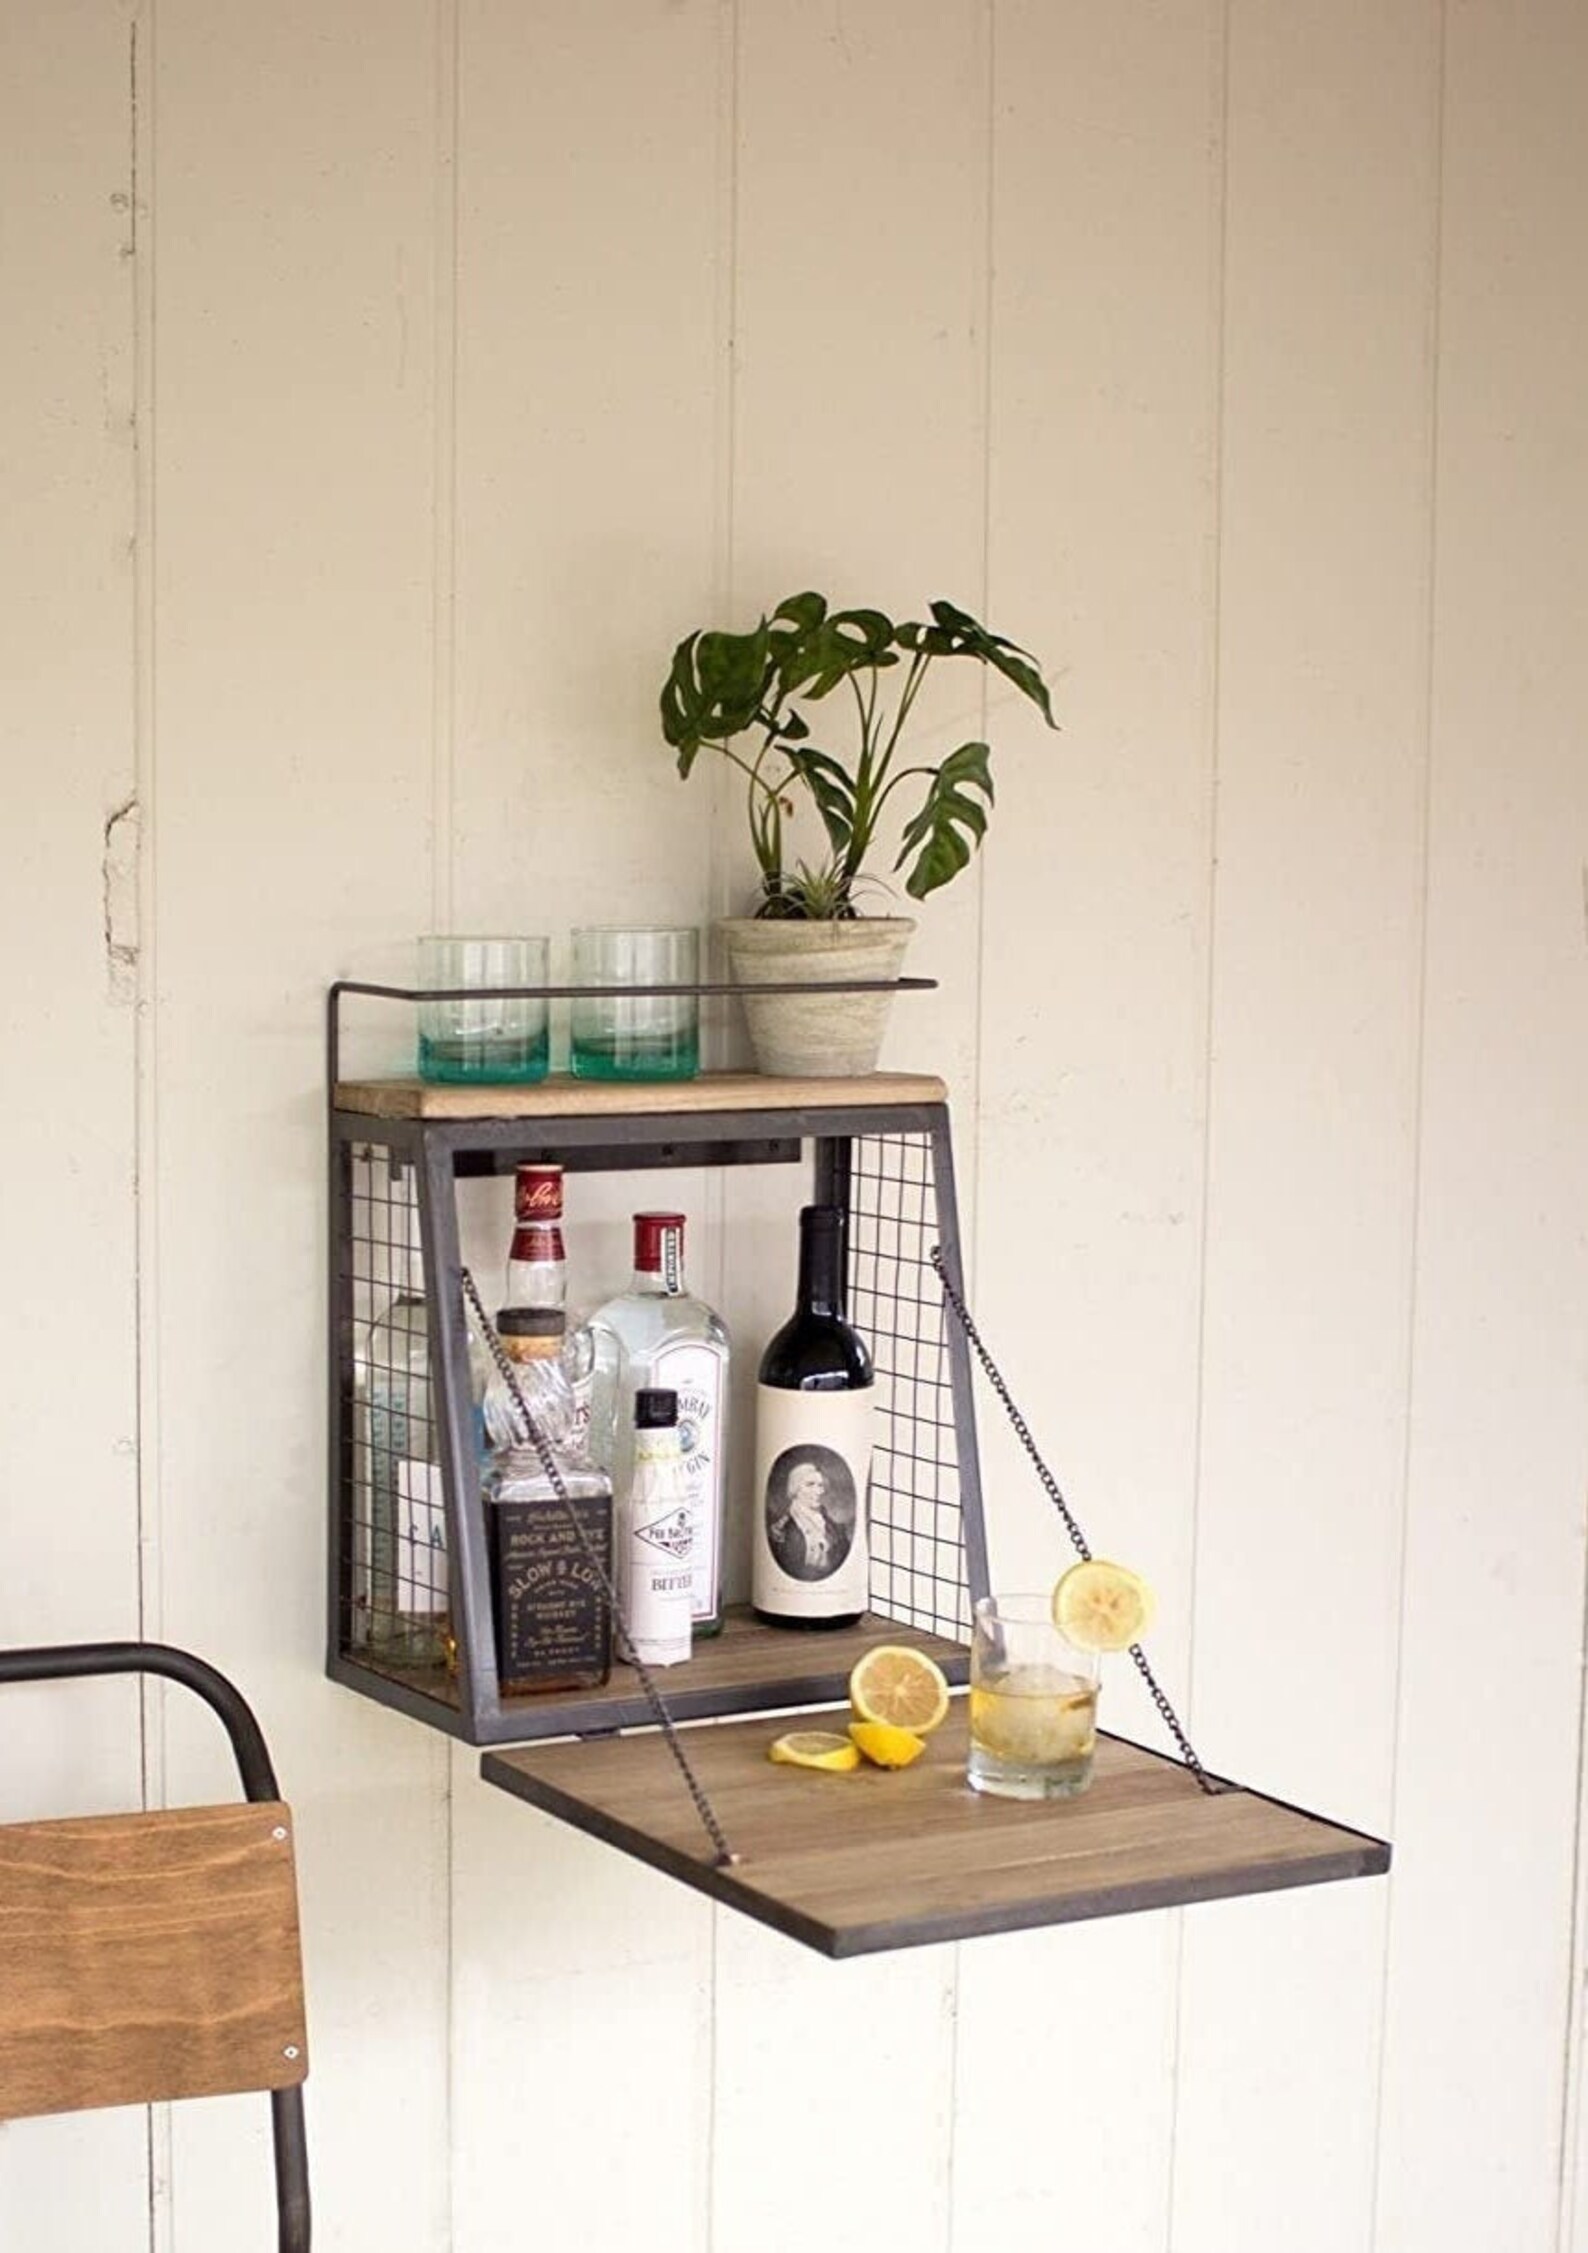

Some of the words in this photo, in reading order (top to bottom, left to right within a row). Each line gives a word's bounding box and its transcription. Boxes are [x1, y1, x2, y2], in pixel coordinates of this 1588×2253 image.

[548, 1530, 575, 1543] AND
[508, 1560, 553, 1600] SLOW
[571, 1562, 603, 1592] LOW
